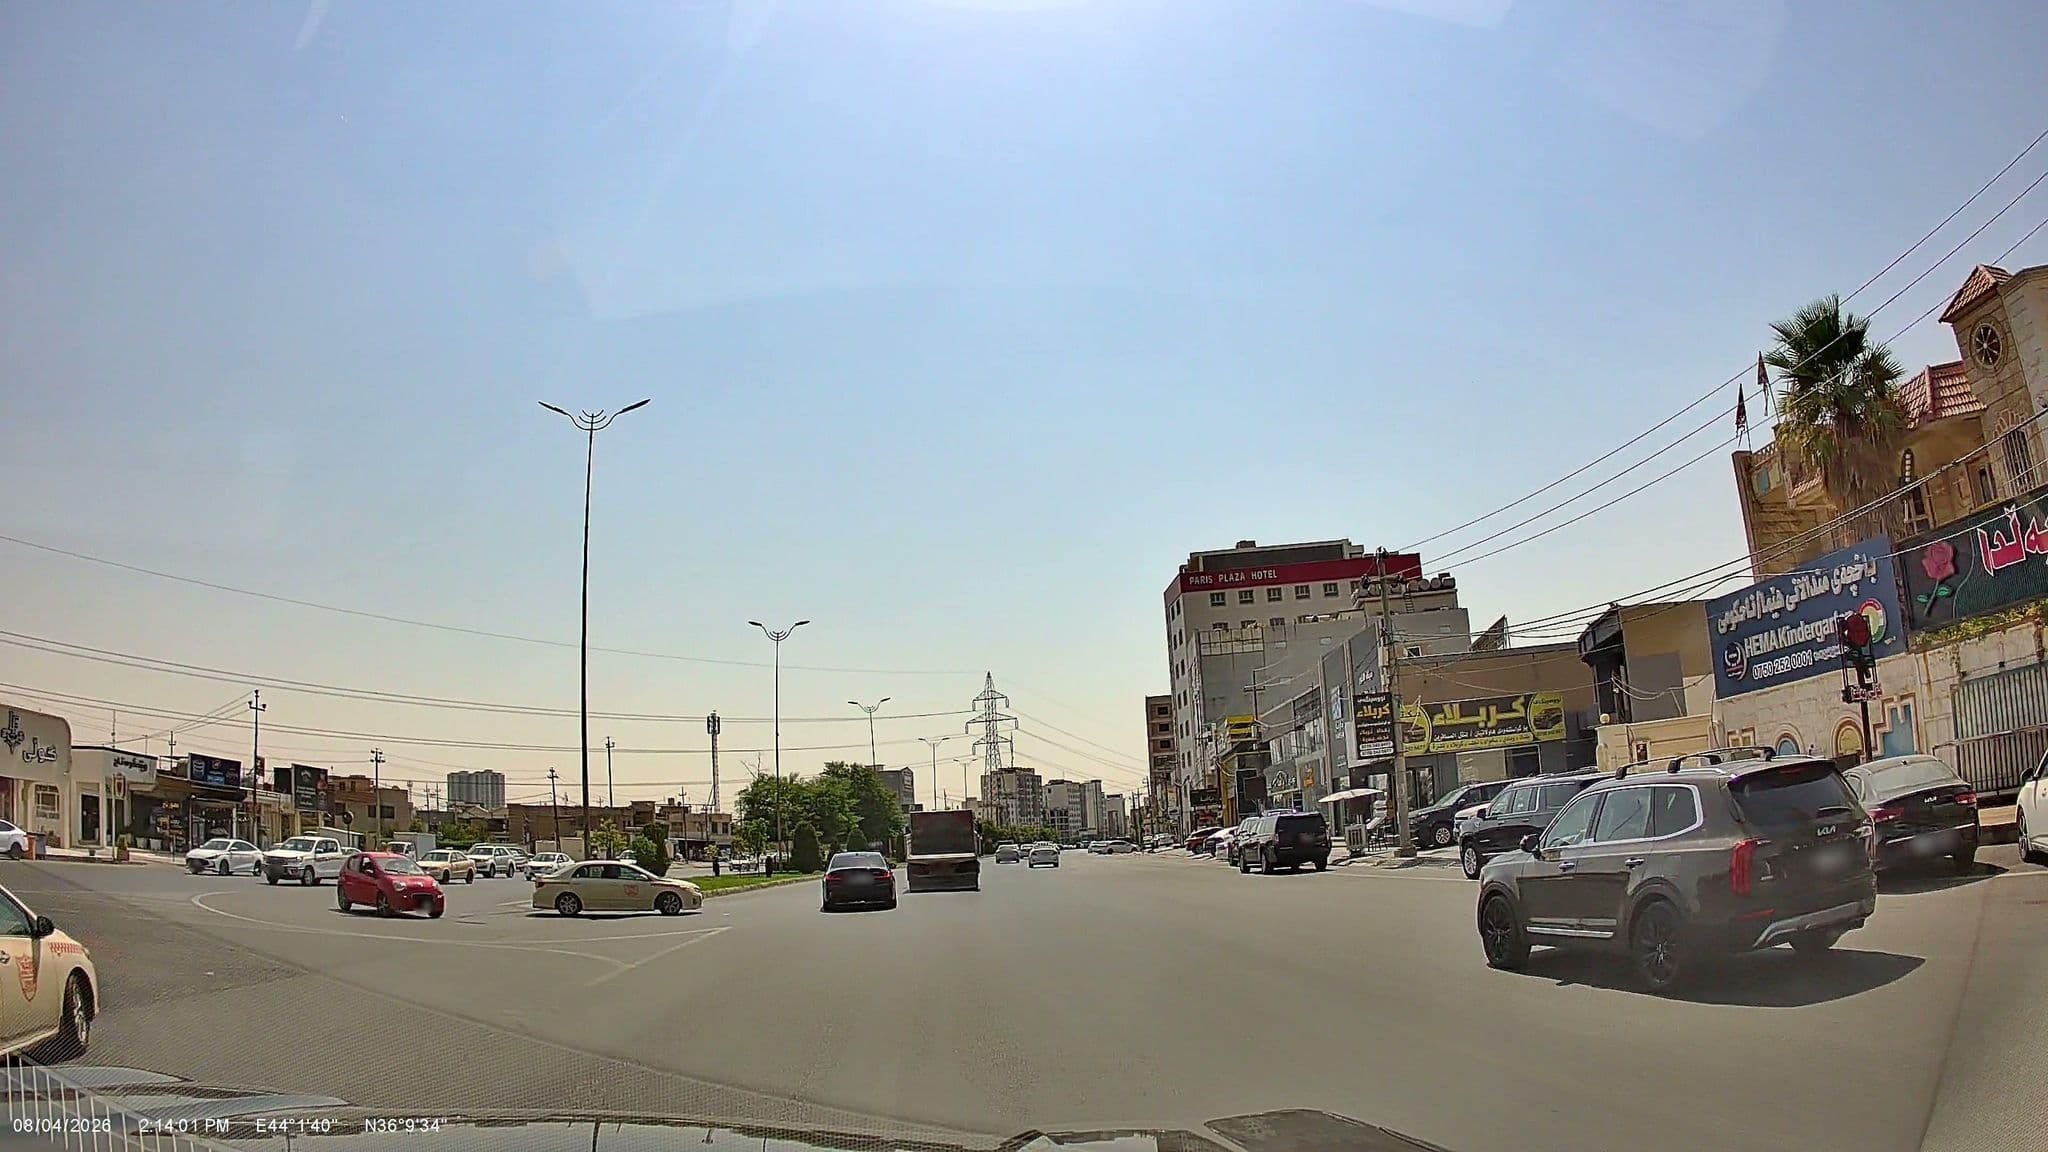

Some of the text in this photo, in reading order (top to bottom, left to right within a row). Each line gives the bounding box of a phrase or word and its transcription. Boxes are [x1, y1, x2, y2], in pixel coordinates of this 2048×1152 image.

[1189, 569, 1278, 585] PARIS PLAZA HOTEL
[1744, 630, 1777, 658] HEMA
[1752, 661, 1774, 680] 0750
[1774, 657, 1791, 676] 252
[1791, 650, 1813, 668] 0001
